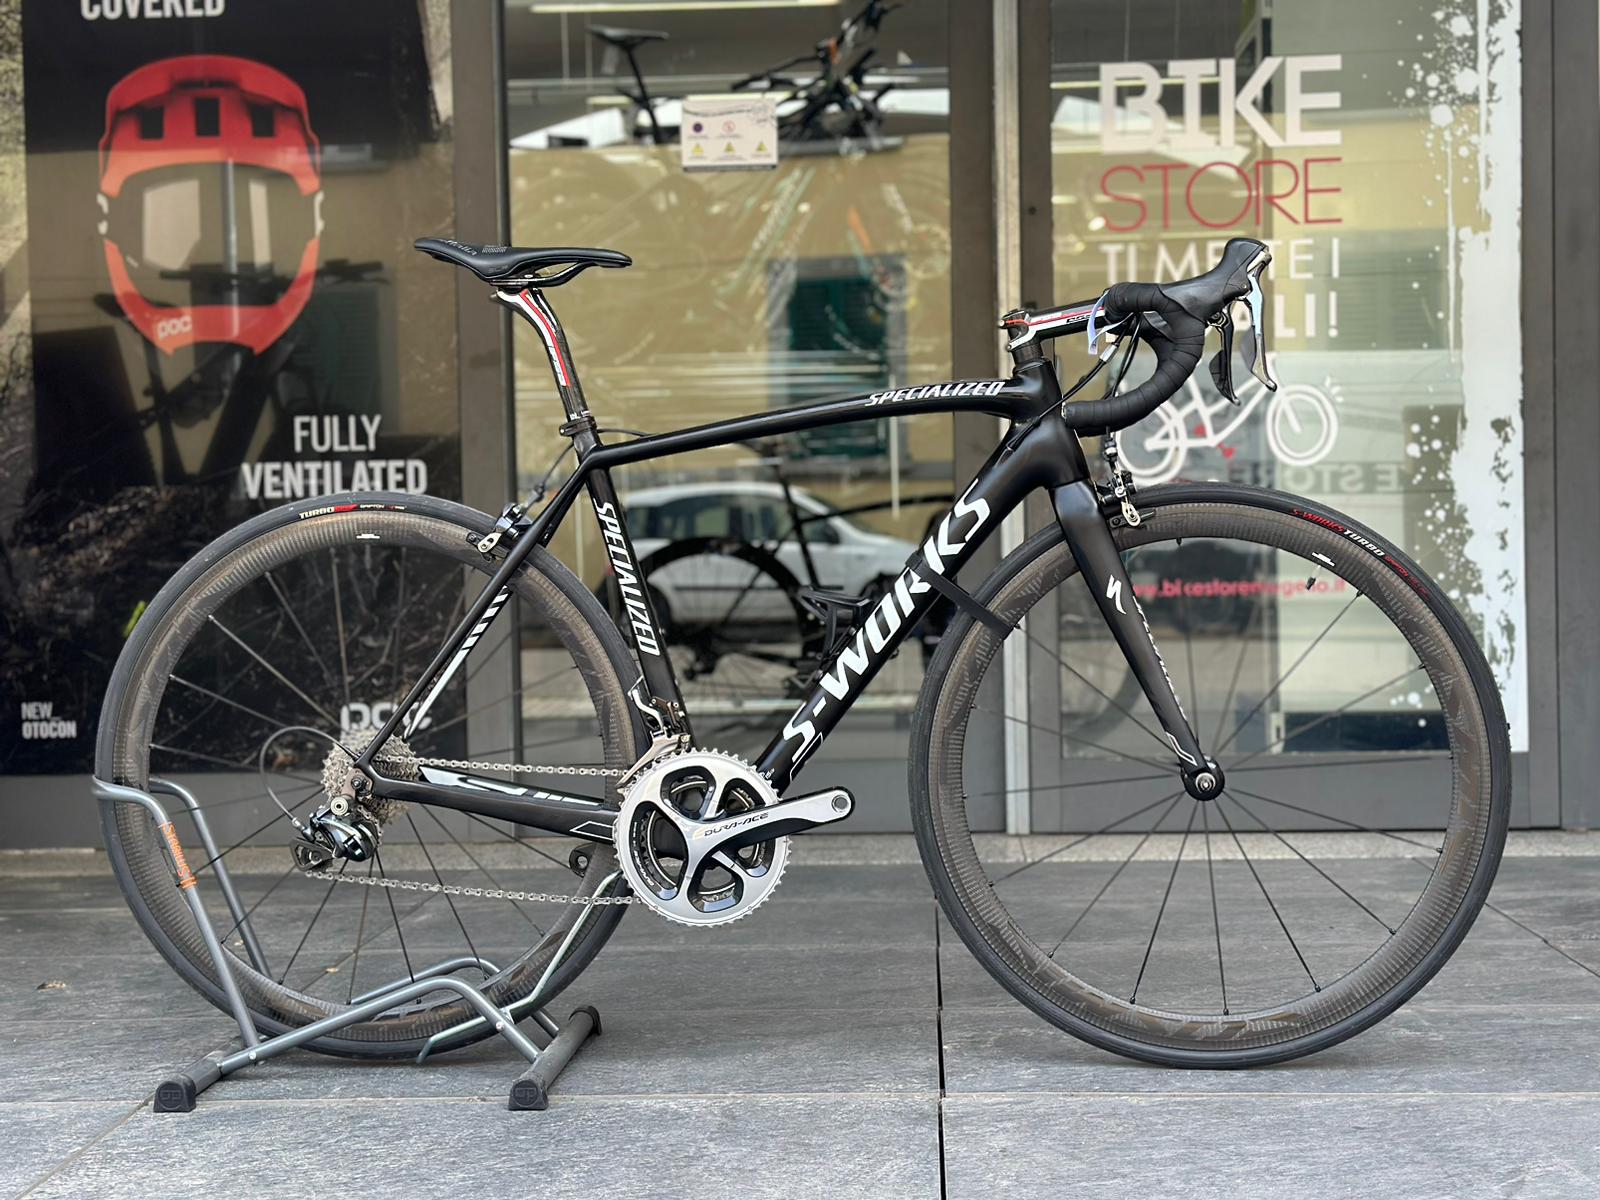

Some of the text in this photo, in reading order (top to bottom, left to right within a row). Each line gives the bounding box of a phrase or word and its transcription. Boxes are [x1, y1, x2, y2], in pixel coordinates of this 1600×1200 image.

[80, 0, 226, 20] COVERED
[1099, 54, 1342, 154] BIKE
[1100, 156, 1342, 232] STORE
[864, 381, 1006, 407] SPECIALIZED
[293, 413, 382, 453] FULLY
[240, 458, 428, 499] VENTILATED
[299, 506, 335, 519] TURBO
[1343, 528, 1386, 557] TURBO
[593, 497, 661, 656] SPECIALIZED
[782, 478, 991, 763] S-WORKS
[22, 720, 77, 740] OTOCON
[704, 812, 769, 837] DURA-ACE
